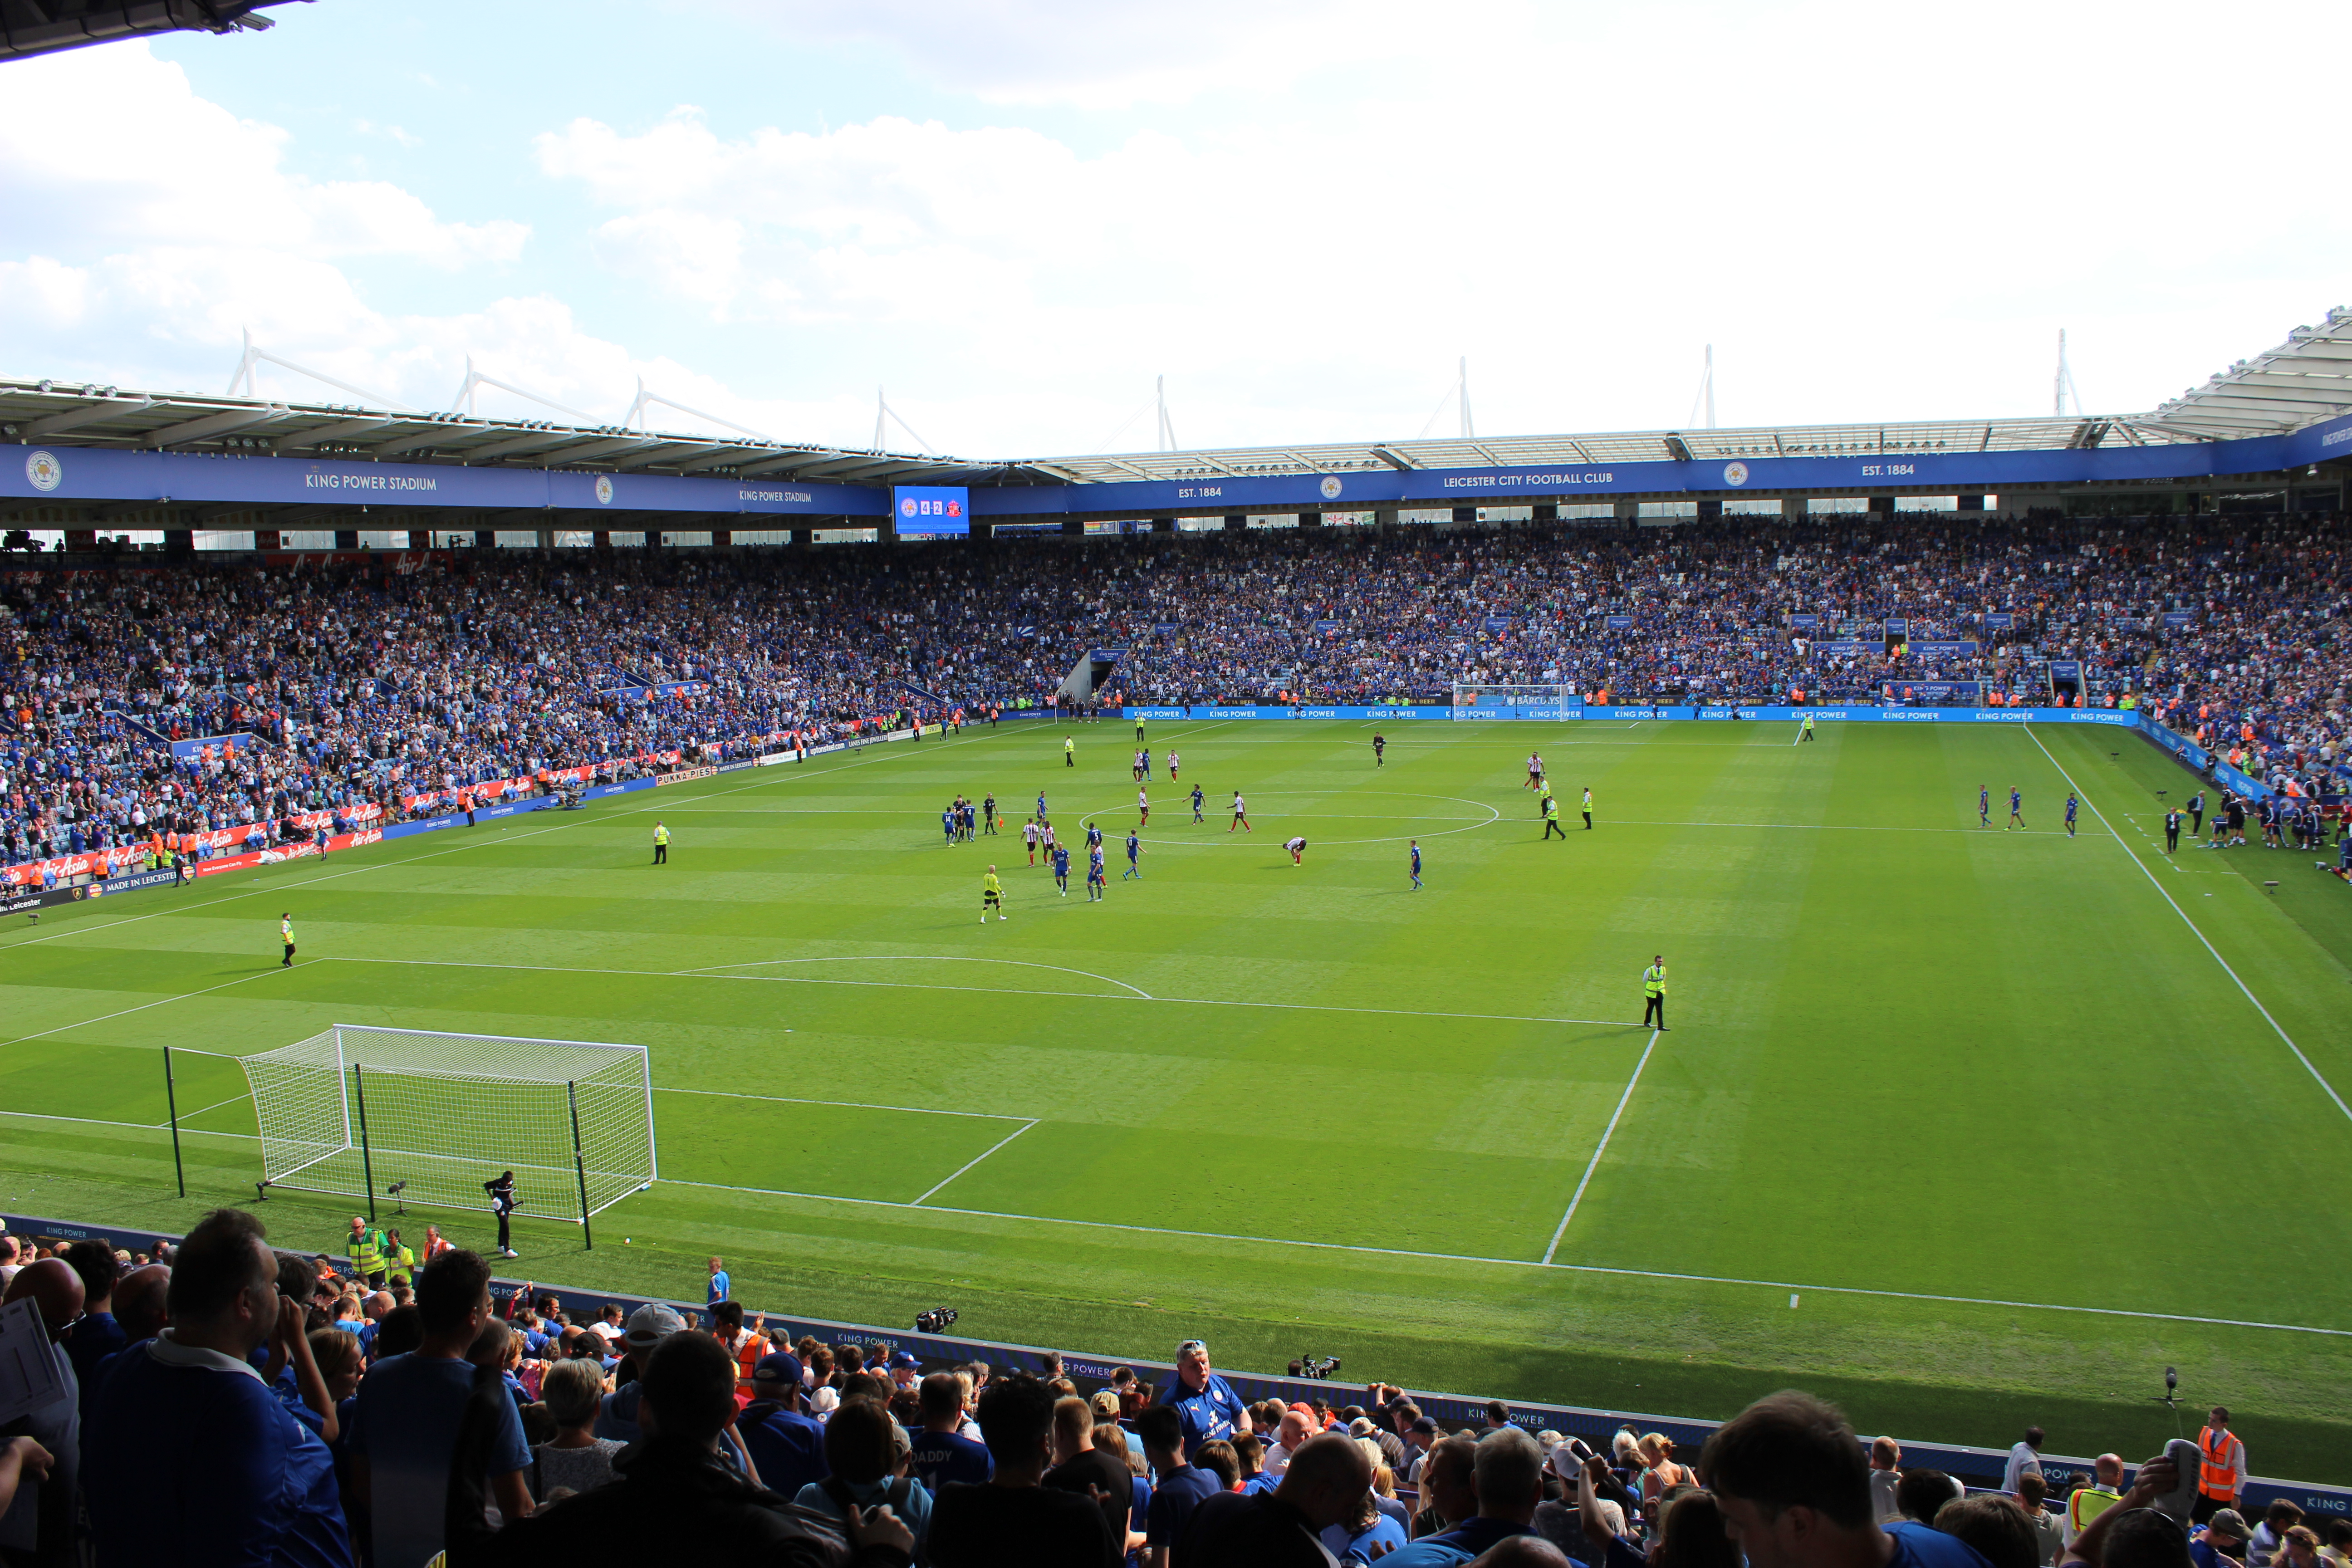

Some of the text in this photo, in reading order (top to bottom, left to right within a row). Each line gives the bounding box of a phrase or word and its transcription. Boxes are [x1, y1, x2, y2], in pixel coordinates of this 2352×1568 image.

[1862, 464, 1914, 476] EST. 1884
[306, 474, 437, 490] KING POWER STADIUM
[1444, 473, 1613, 488] LEICESTER CITY FOOTBALL CLUB
[739, 490, 812, 503] KING POWER STADIUM
[1179, 487, 1221, 498] EST. 1884
[922, 504, 928, 513] 4
[935, 504, 940, 513] 2
[2096, 714, 2123, 722] POWER
[192, 745, 204, 754] KIN
[810, 743, 845, 756] uptonsteel.com
[849, 740, 860, 749] LANES
[735, 761, 752, 770] LEICESTER
[657, 767, 710, 785] PUKKA-PIES
[1094, 832, 1099, 840] 5
[107, 879, 129, 892] MADE
[130, 878, 139, 889] IN
[9, 898, 41, 910] Leicester
[64, 1229, 86, 1238] POWER
[838, 1333, 898, 1348] KING POWER
[1073, 1363, 1110, 1376] POWER
[1468, 1408, 1544, 1425] KIN OWER
[1202, 1419, 1230, 1441] KING POWER
[911, 1450, 952, 1463] DADDY
[2307, 1497, 2347, 1511] KING
